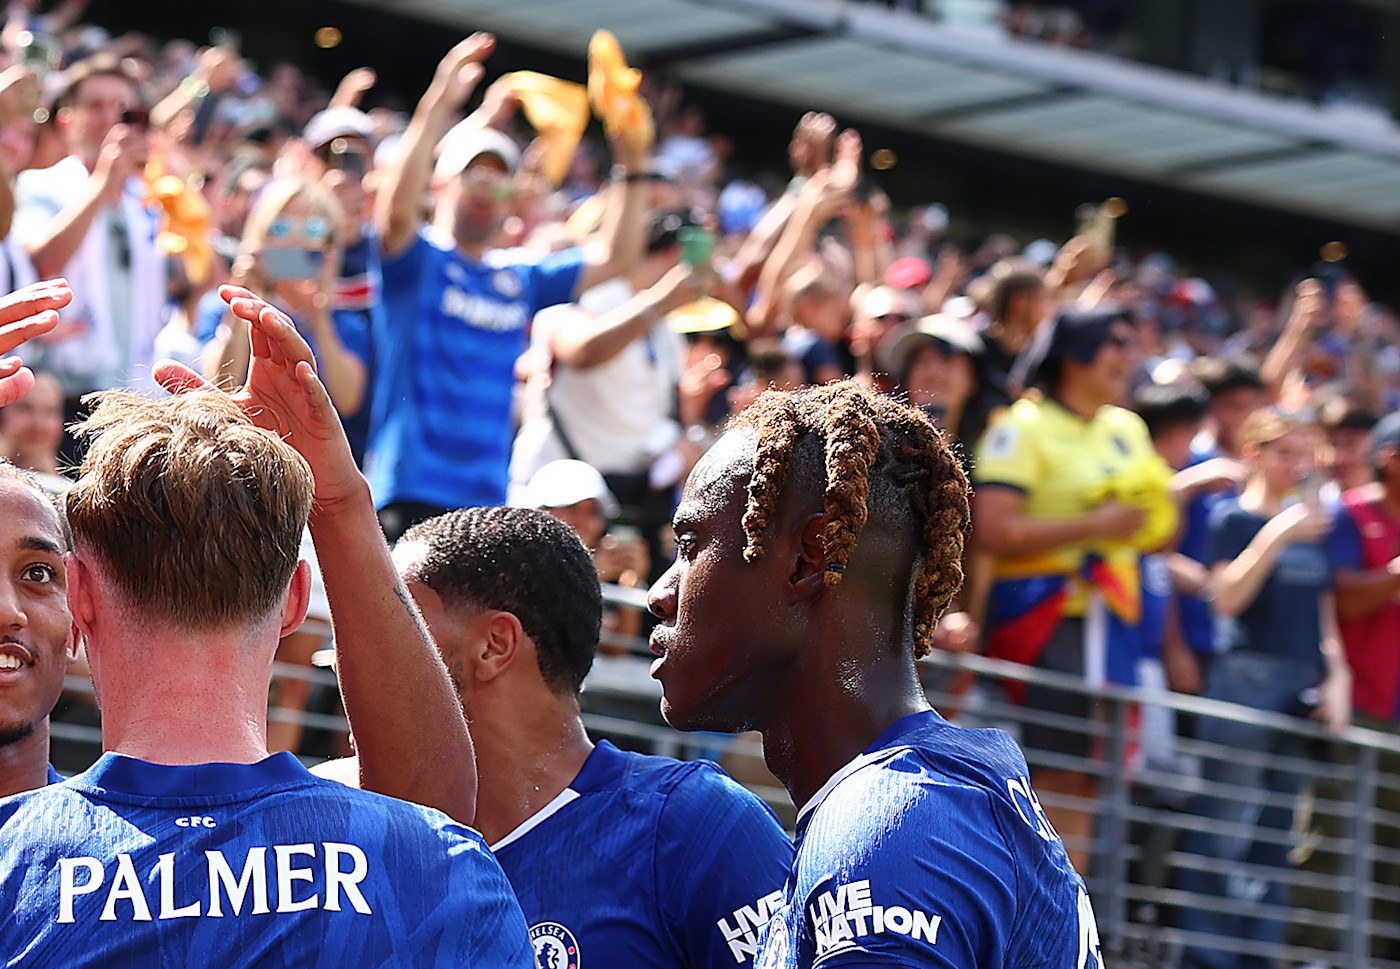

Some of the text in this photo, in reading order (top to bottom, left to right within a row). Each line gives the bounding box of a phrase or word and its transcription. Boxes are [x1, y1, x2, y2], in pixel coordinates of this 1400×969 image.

[175, 816, 217, 828] CFC
[56, 842, 373, 924] PALMER
[809, 879, 873, 929] LIVE
[531, 925, 566, 941] ELSEA
[717, 889, 785, 942] LIVE
[815, 905, 942, 957] NATION
